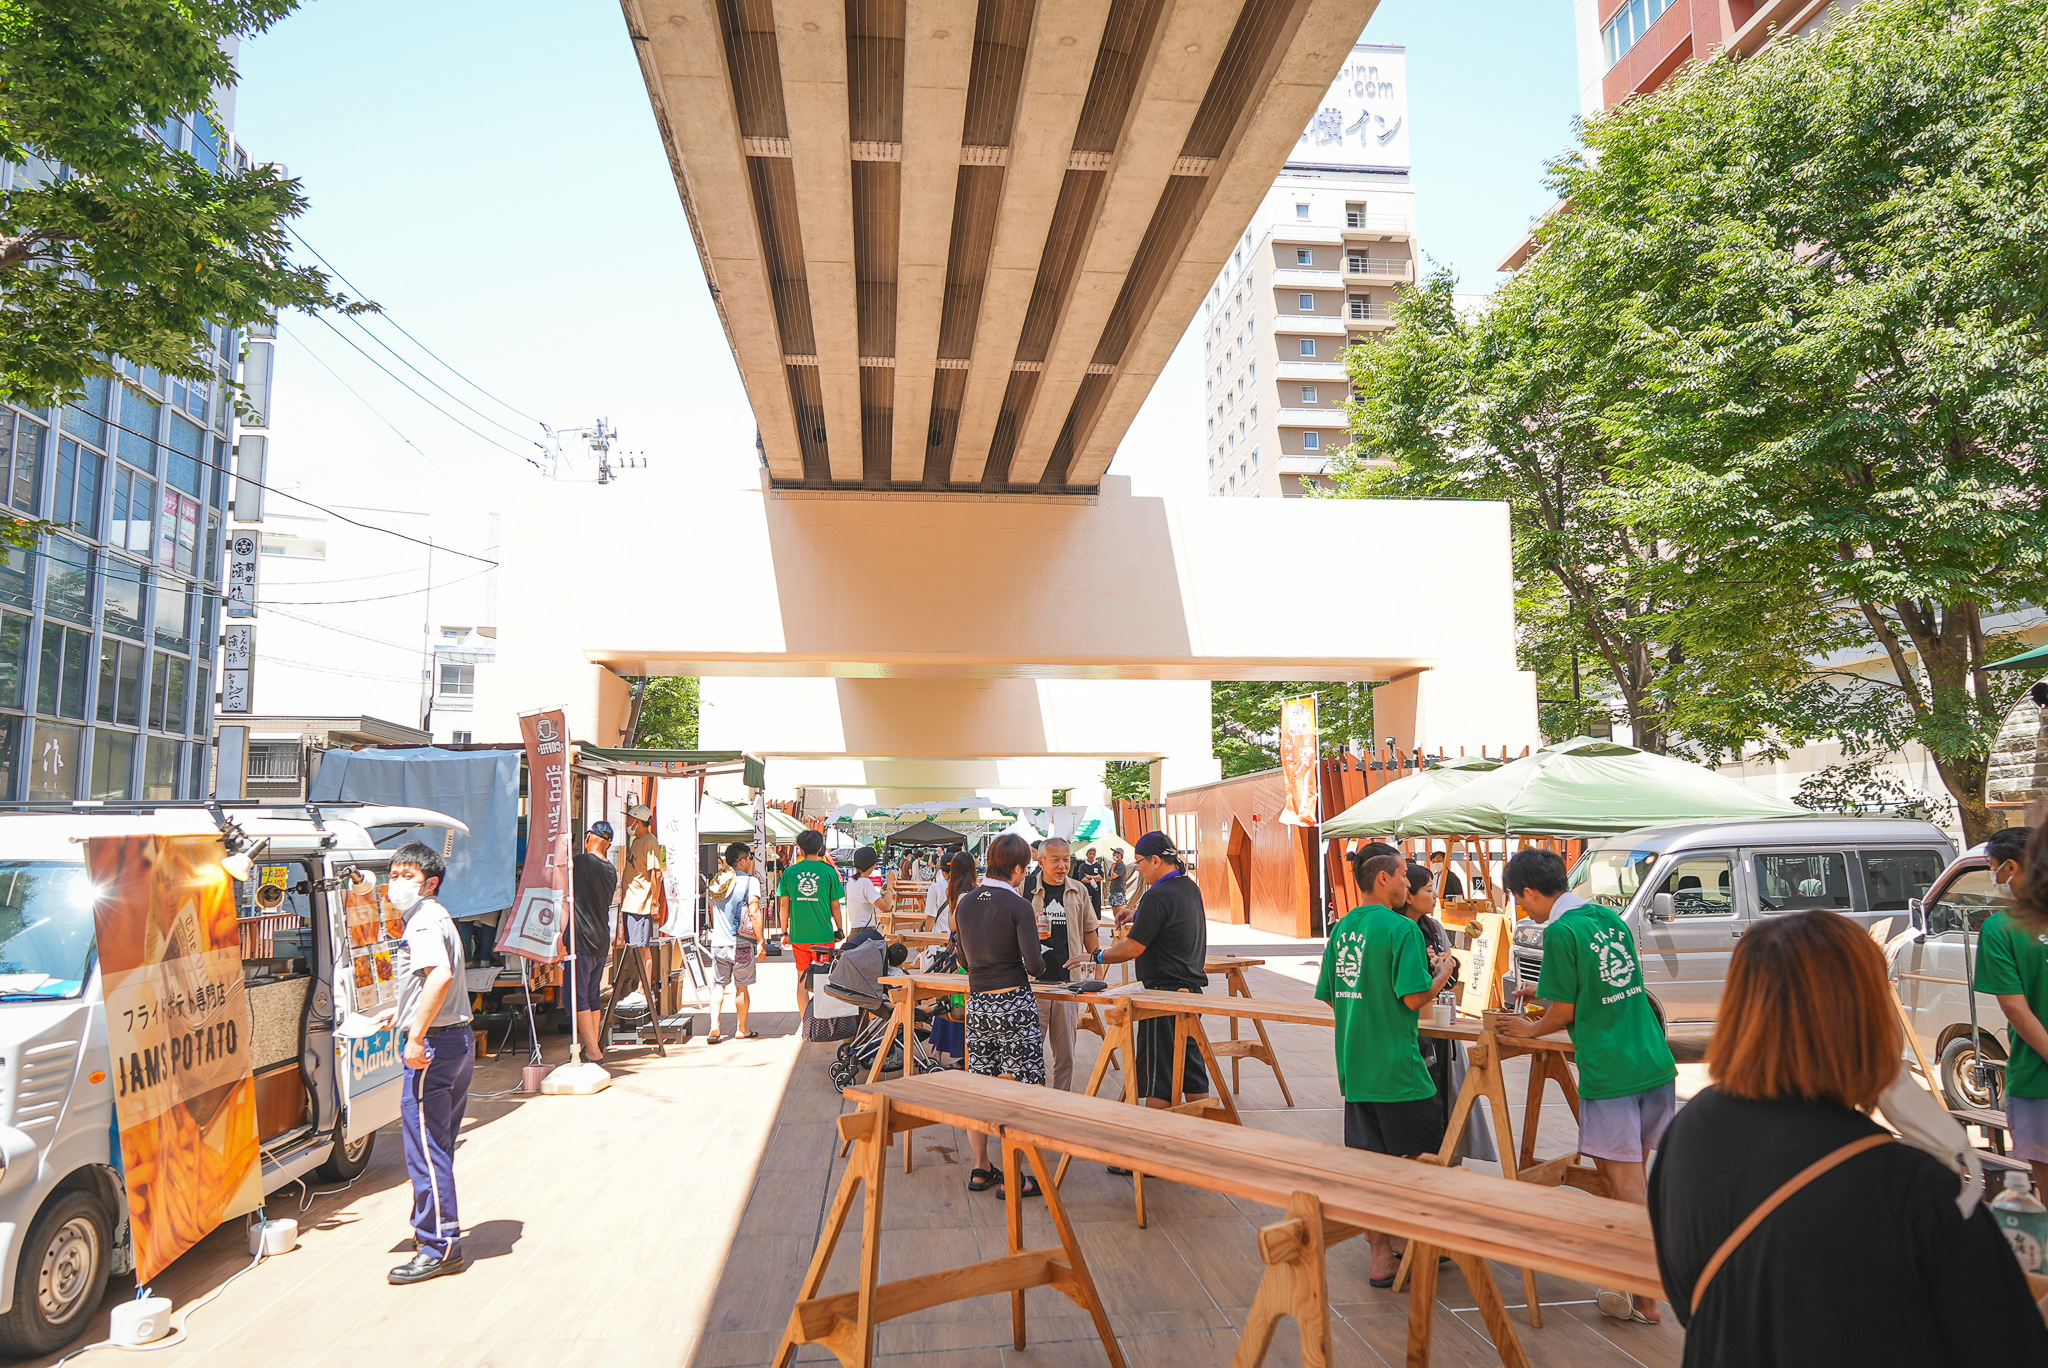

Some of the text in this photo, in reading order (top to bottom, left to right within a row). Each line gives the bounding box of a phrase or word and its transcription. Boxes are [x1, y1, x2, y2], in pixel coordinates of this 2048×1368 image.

[1349, 80, 1393, 99] .com
[1302, 108, 1401, 147] 横イン
[797, 871, 820, 880] STAFF
[1590, 927, 1625, 953] STAFF
[123, 981, 226, 1033] フライドポテト専門店
[1601, 992, 1625, 1005] ENSHU
[170, 1019, 238, 1076] POTATO
[352, 1028, 395, 1081] Stand
